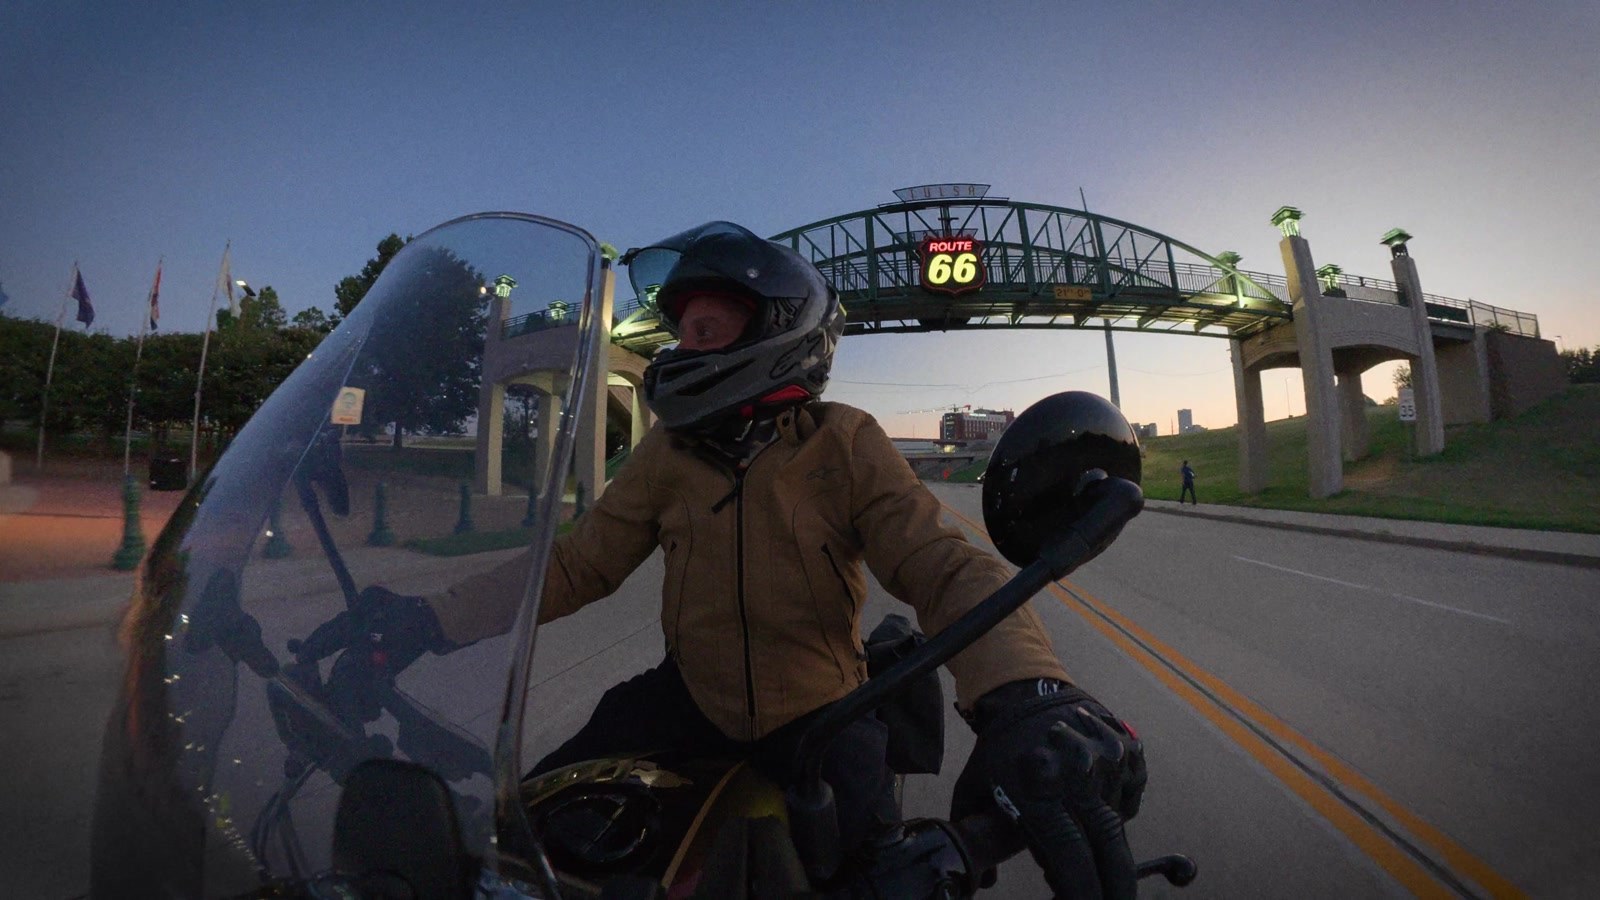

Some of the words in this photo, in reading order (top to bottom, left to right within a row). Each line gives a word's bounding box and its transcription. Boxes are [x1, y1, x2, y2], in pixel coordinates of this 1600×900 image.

[909, 185, 976, 200] TULSA
[929, 241, 973, 252] ROUTE
[928, 252, 977, 285] 66
[1401, 404, 1415, 417] 35
